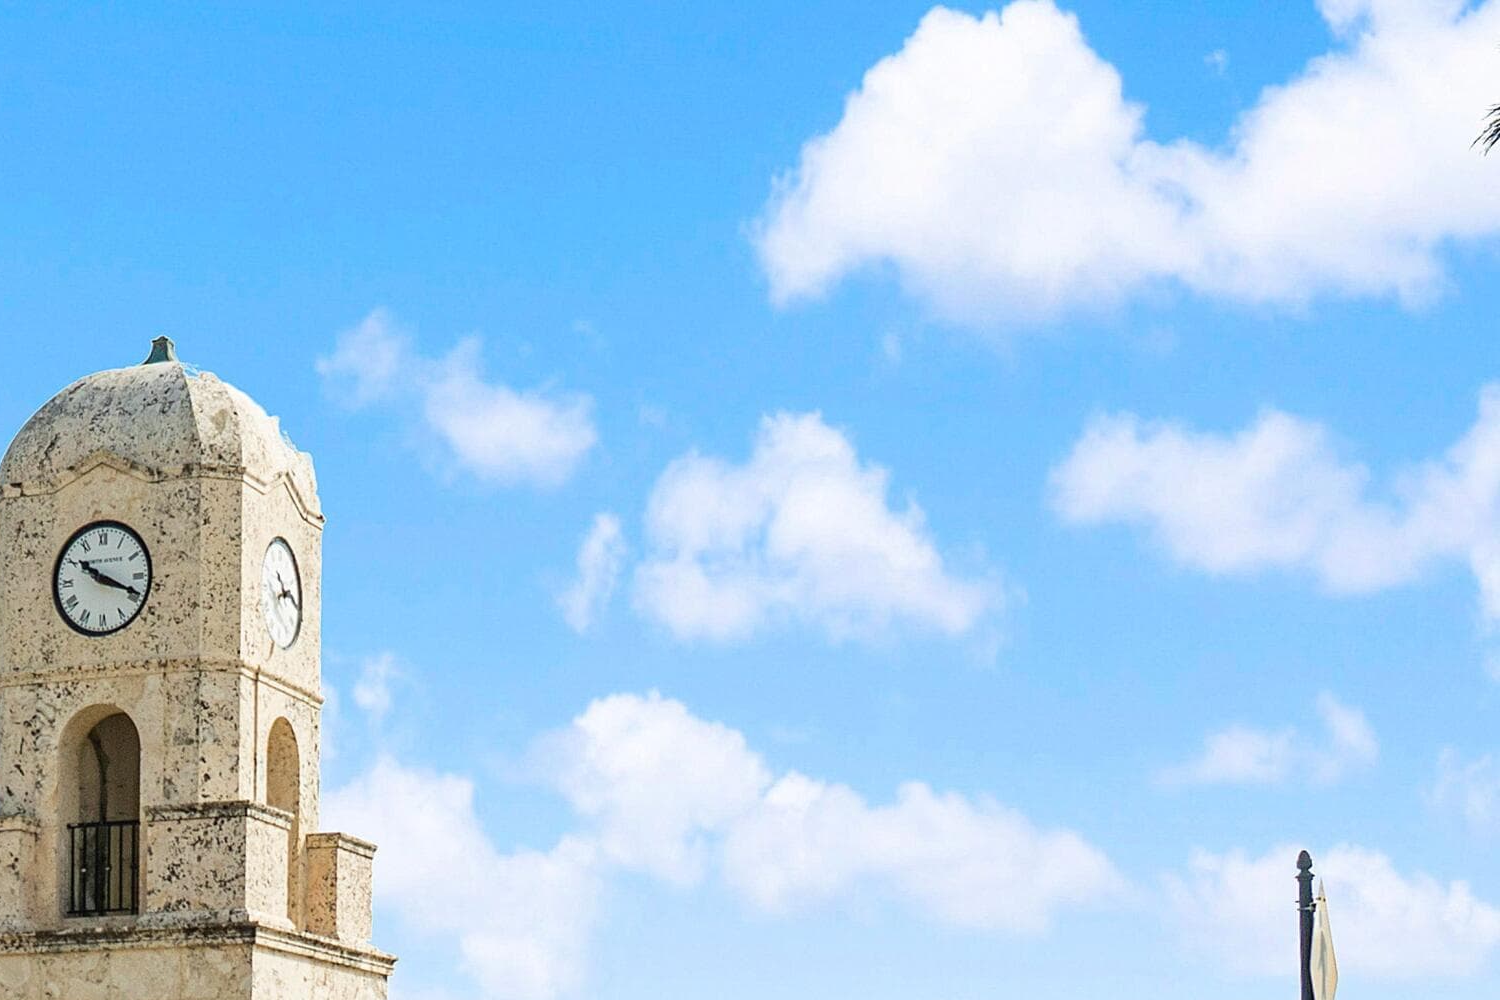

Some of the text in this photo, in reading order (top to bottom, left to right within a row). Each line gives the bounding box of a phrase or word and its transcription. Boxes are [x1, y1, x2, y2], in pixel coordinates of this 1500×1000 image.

[98, 532, 108, 546] XII
[117, 535, 125, 549] I
[81, 540, 91, 554] XI
[67, 558, 78, 568] X
[62, 579, 73, 589] IX
[99, 613, 107, 627] VI
